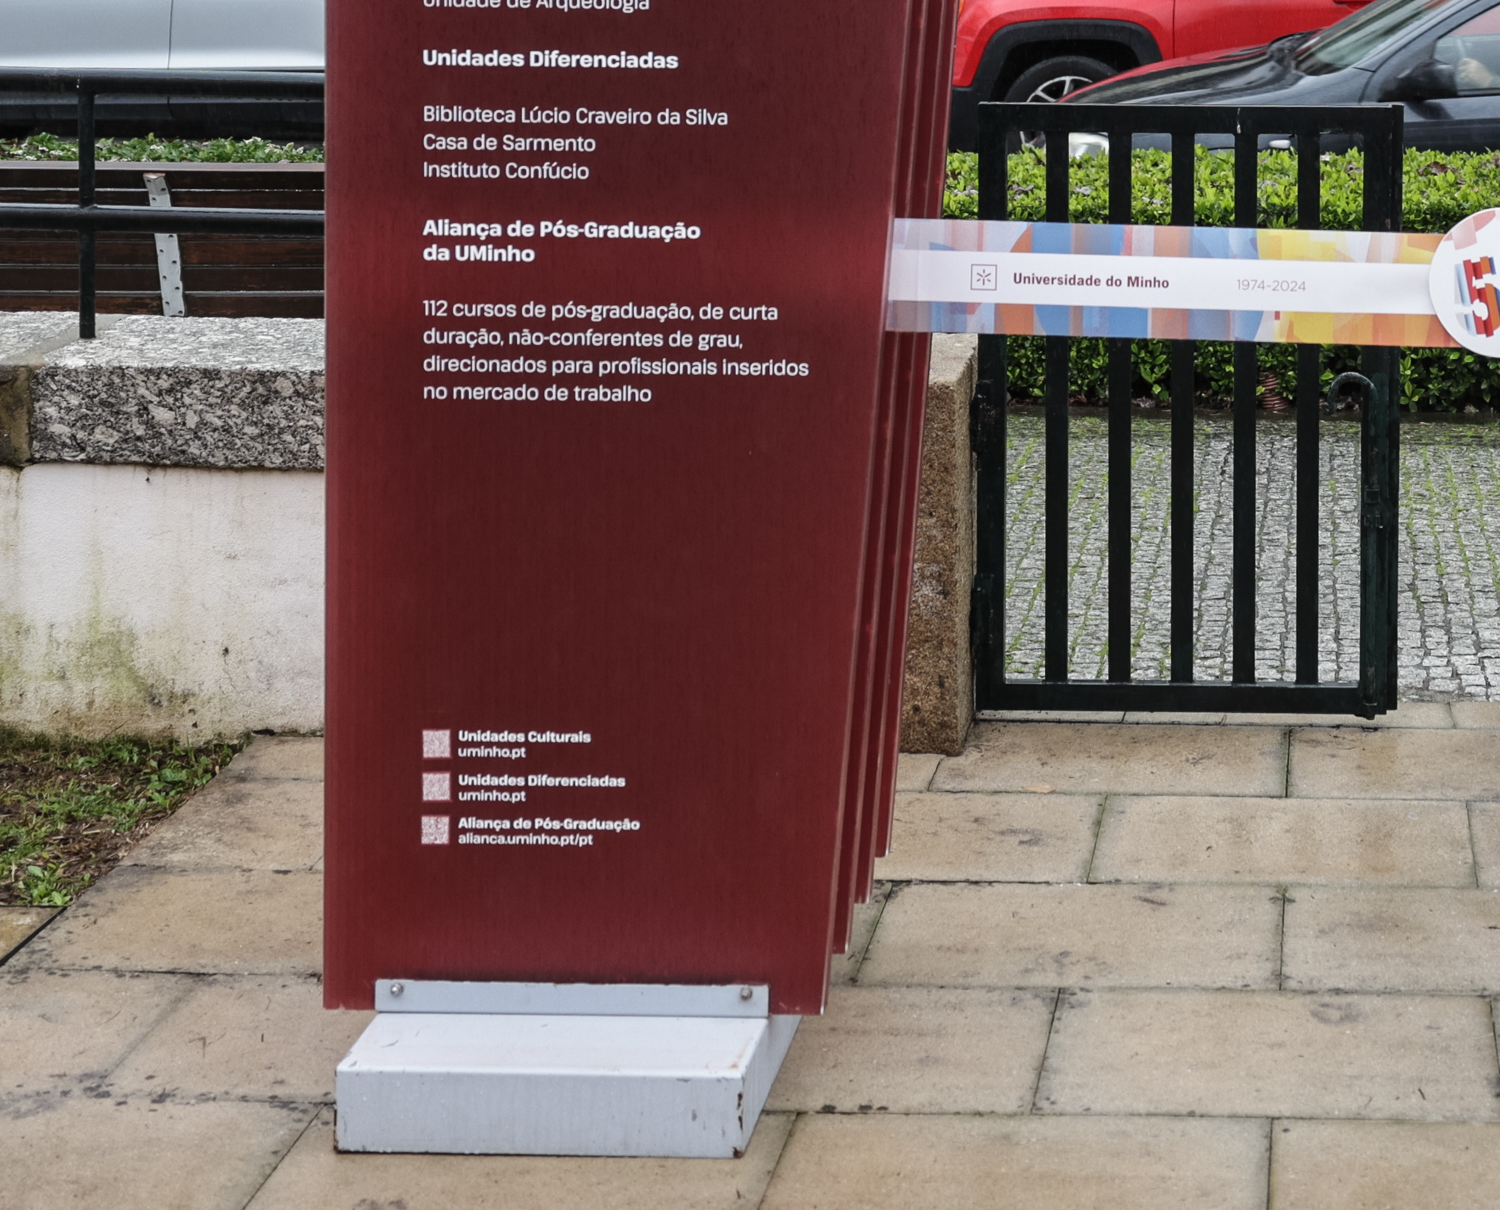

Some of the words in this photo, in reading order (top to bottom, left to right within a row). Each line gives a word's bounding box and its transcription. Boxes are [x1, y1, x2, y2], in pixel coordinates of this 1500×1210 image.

[422, 48, 525, 67] Unidades
[529, 49, 679, 69] Diferenciadas
[423, 104, 516, 124] Biblioteca
[521, 105, 571, 124] Lúcio
[575, 107, 652, 125] Craveiro
[656, 107, 681, 126] da
[685, 108, 728, 126] Silva
[423, 133, 468, 151] Casa
[472, 133, 498, 151] de
[502, 134, 596, 152] Sarmento
[423, 161, 501, 179] Instituto
[505, 161, 590, 180] Confúcio
[422, 218, 503, 241] Aliança
[506, 219, 536, 238] de
[539, 219, 701, 243] Pós-Graduação
[422, 243, 451, 262] da
[454, 243, 536, 263] UMinho
[1013, 272, 1102, 287] Universidade
[1105, 275, 1123, 288] do
[1126, 275, 1170, 289] Minho
[1236, 278, 1307, 293] 1974-2024
[422, 299, 448, 317] 112
[452, 303, 517, 318] cursos
[521, 300, 547, 318] de
[551, 300, 695, 323] pós-graduação,
[698, 302, 724, 320] de
[729, 304, 779, 321] curta
[423, 327, 504, 349] duração,
[508, 328, 664, 348] não-conferentes
[668, 330, 694, 348] de
[697, 333, 743, 351] grau,
[423, 354, 547, 374] direcionados
[551, 359, 594, 377] para
[598, 356, 718, 378] profissionais
[722, 358, 810, 377] inseridos
[423, 385, 448, 400] no
[452, 383, 540, 401] mercado
[543, 383, 569, 402] de
[573, 384, 652, 403] trabalho
[458, 729, 526, 743] Unidades
[527, 730, 592, 743] Culturais
[457, 745, 526, 760] uminho.pt
[458, 773, 526, 787] Unidades
[527, 773, 626, 788] Diferenciadas
[458, 789, 526, 804] uminho.pt
[457, 816, 511, 832] Aliança
[512, 817, 532, 830] de
[534, 816, 641, 833] Pós-Graduação
[458, 832, 594, 848] alianca.uminho.pt/pt
